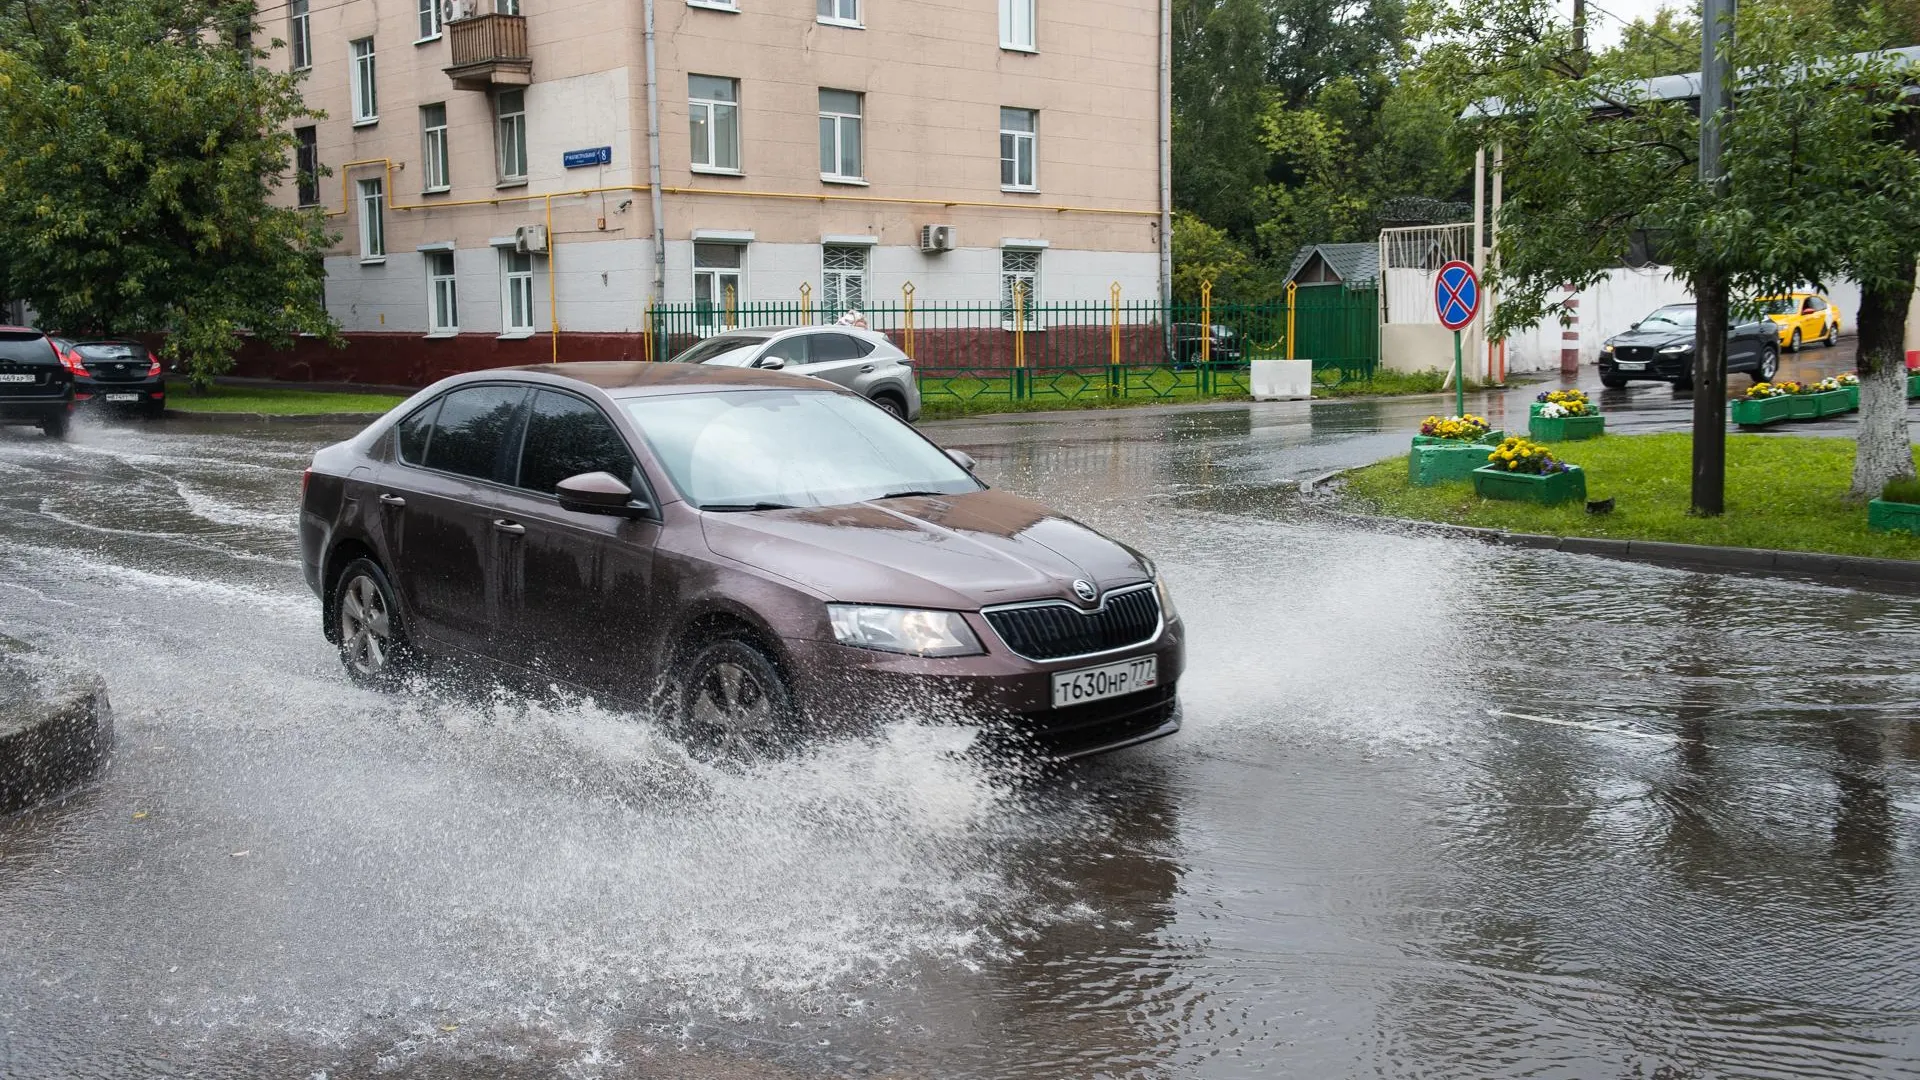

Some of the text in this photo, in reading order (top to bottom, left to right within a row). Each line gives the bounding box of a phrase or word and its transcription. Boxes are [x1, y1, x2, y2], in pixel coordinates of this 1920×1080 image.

[601, 149, 607, 161] 8
[1060, 659, 1153, 702] Т630НР 777
